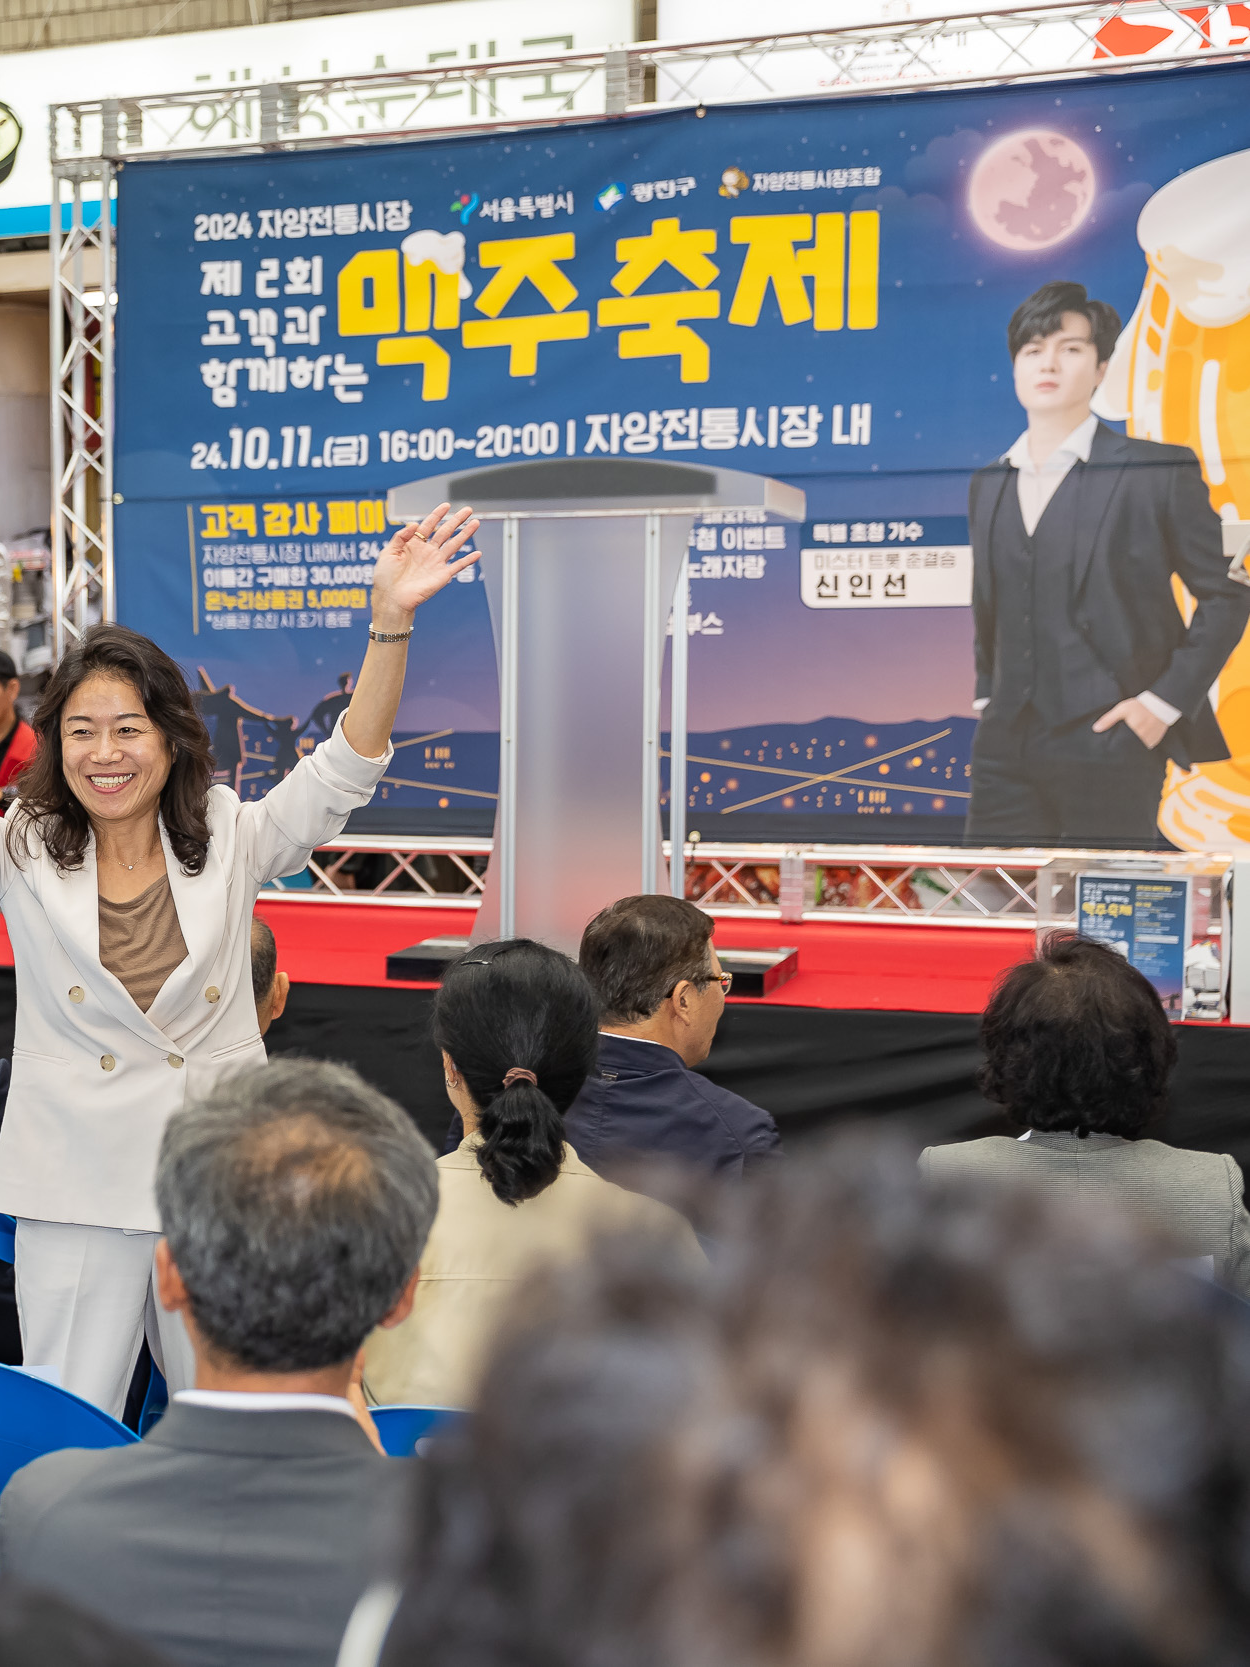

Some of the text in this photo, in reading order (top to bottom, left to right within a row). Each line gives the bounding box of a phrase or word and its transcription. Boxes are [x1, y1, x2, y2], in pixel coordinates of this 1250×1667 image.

[630, 176, 697, 205] 광진구
[752, 166, 882, 193] 자양전통시장조합
[194, 199, 412, 242] 2024 자양전통시장
[478, 191, 575, 223] 서울특별시
[200, 259, 242, 297] 제
[337, 210, 881, 402] 맥주축제
[201, 304, 327, 357] 고객과
[200, 353, 369, 408] 함께하는
[379, 421, 559, 463] 16:00~20:00
[583, 406, 823, 456] 자양전통시장
[831, 403, 872, 446] 내
[201, 500, 403, 539] 고객 감사 페이
[813, 520, 924, 543] 특별 초청 가수
[722, 526, 787, 550] 이벤트
[202, 543, 302, 566] 자양전통시장
[304, 540, 357, 564] 내에서
[814, 550, 957, 571] 미스터 트롯 준결승
[203, 563, 375, 588] 이틀간 구매한 30,000원
[204, 587, 368, 612] 온누리상품권 5,000원
[252, 610, 279, 631] 소진
[296, 609, 324, 629] 조기
